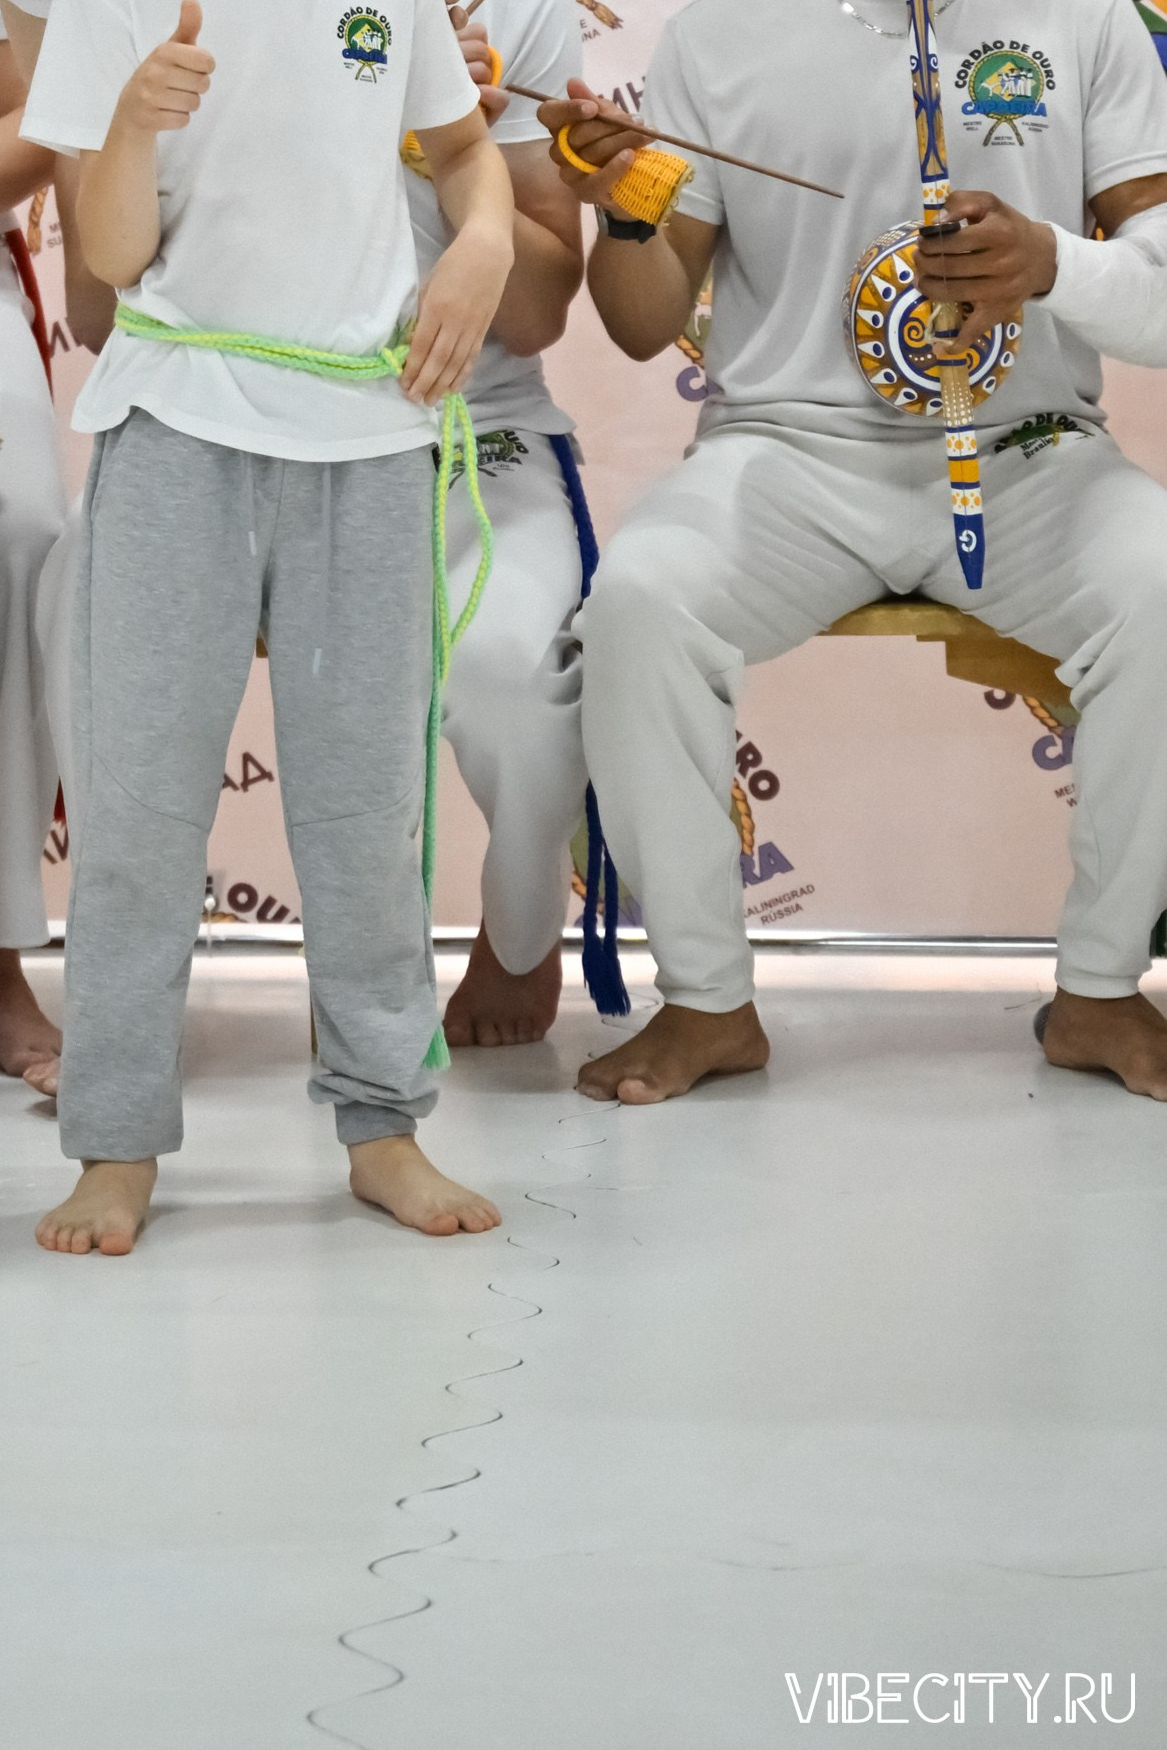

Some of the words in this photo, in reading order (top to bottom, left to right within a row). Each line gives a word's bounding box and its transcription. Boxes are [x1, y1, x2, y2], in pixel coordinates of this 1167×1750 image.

[366, 7, 378, 17] DE
[1009, 40, 1030, 53] DE
[1032, 51, 1056, 91] OURO
